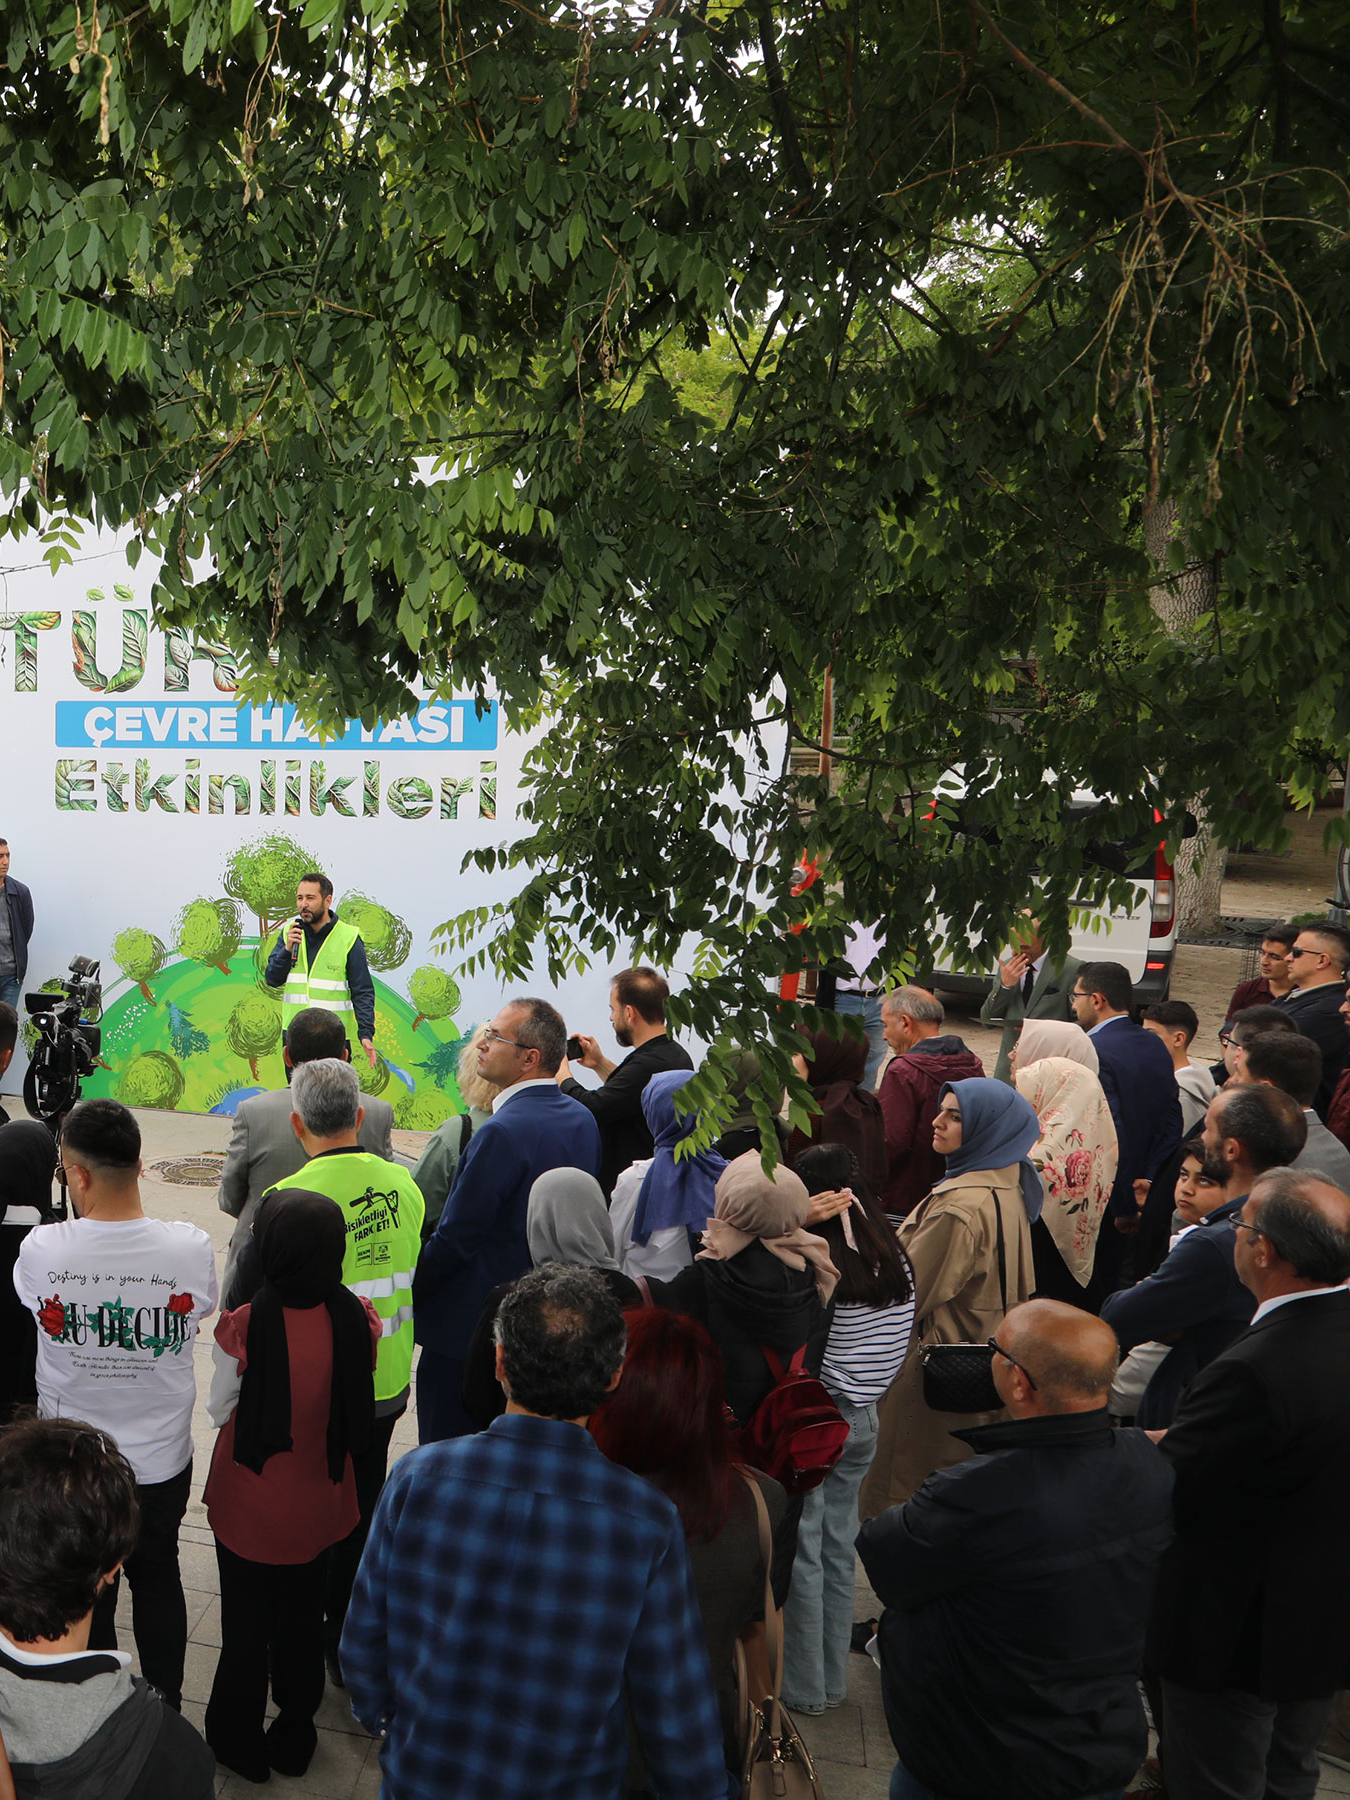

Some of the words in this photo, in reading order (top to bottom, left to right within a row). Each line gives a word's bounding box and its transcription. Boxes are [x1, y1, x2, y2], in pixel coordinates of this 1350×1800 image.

[84, 706, 238, 748] ÇEVRE
[250, 706, 464, 744] HAASI
[55, 758, 498, 820] Etkinlikleri
[354, 1224, 374, 1243] FARK
[376, 1219, 390, 1232] ET!
[47, 1270, 87, 1286] Destiny
[92, 1273, 100, 1284] is
[105, 1273, 115, 1281] in
[119, 1275, 146, 1287] your
[151, 1273, 178, 1290] Hands
